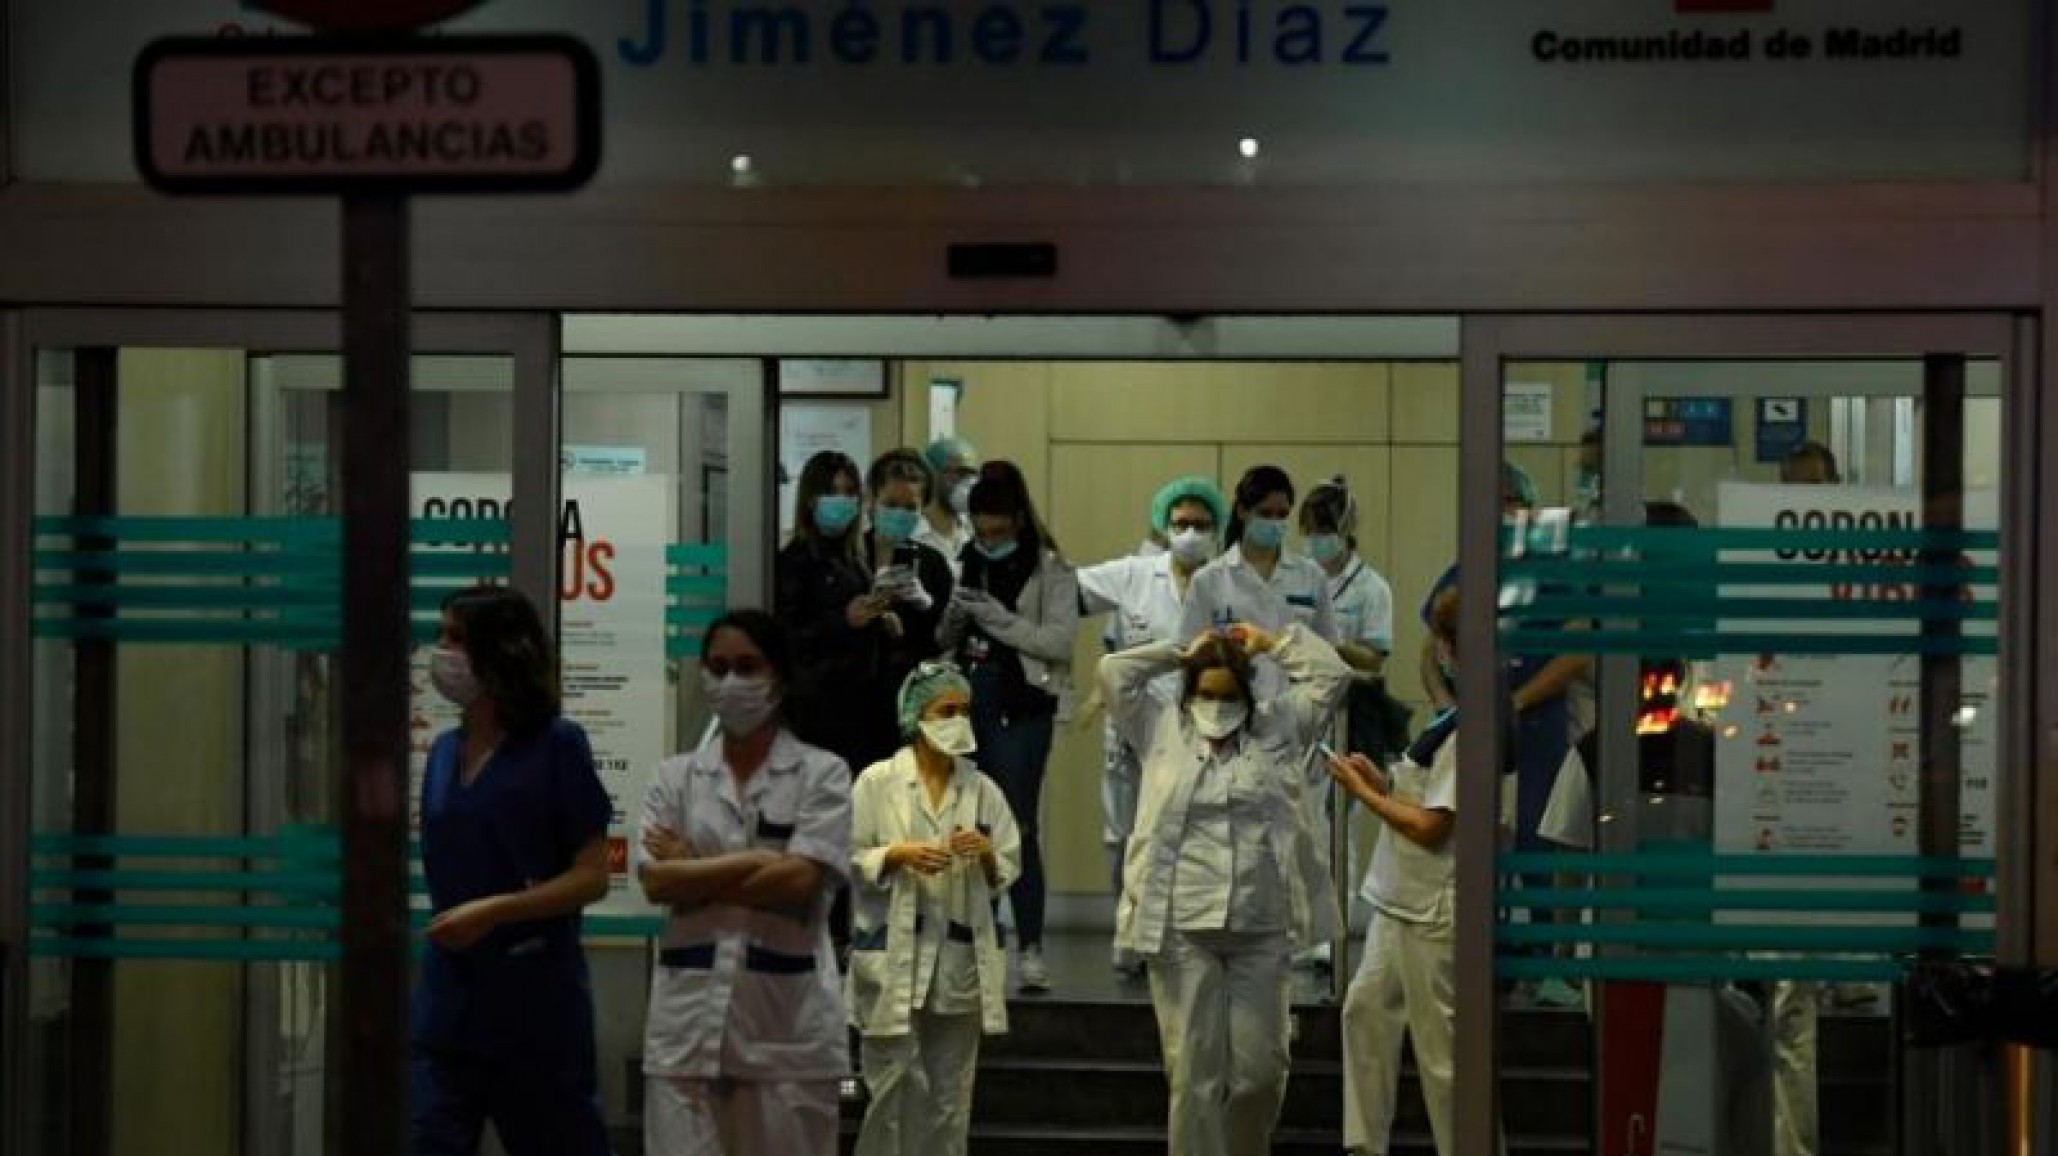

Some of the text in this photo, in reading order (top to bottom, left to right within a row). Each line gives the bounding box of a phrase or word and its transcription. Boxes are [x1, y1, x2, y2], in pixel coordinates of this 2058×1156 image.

[1532, 29, 1961, 60] Comunidad de Madrid
[247, 66, 481, 105] EXCEPTO
[185, 122, 549, 163] AMBULANCIAS
